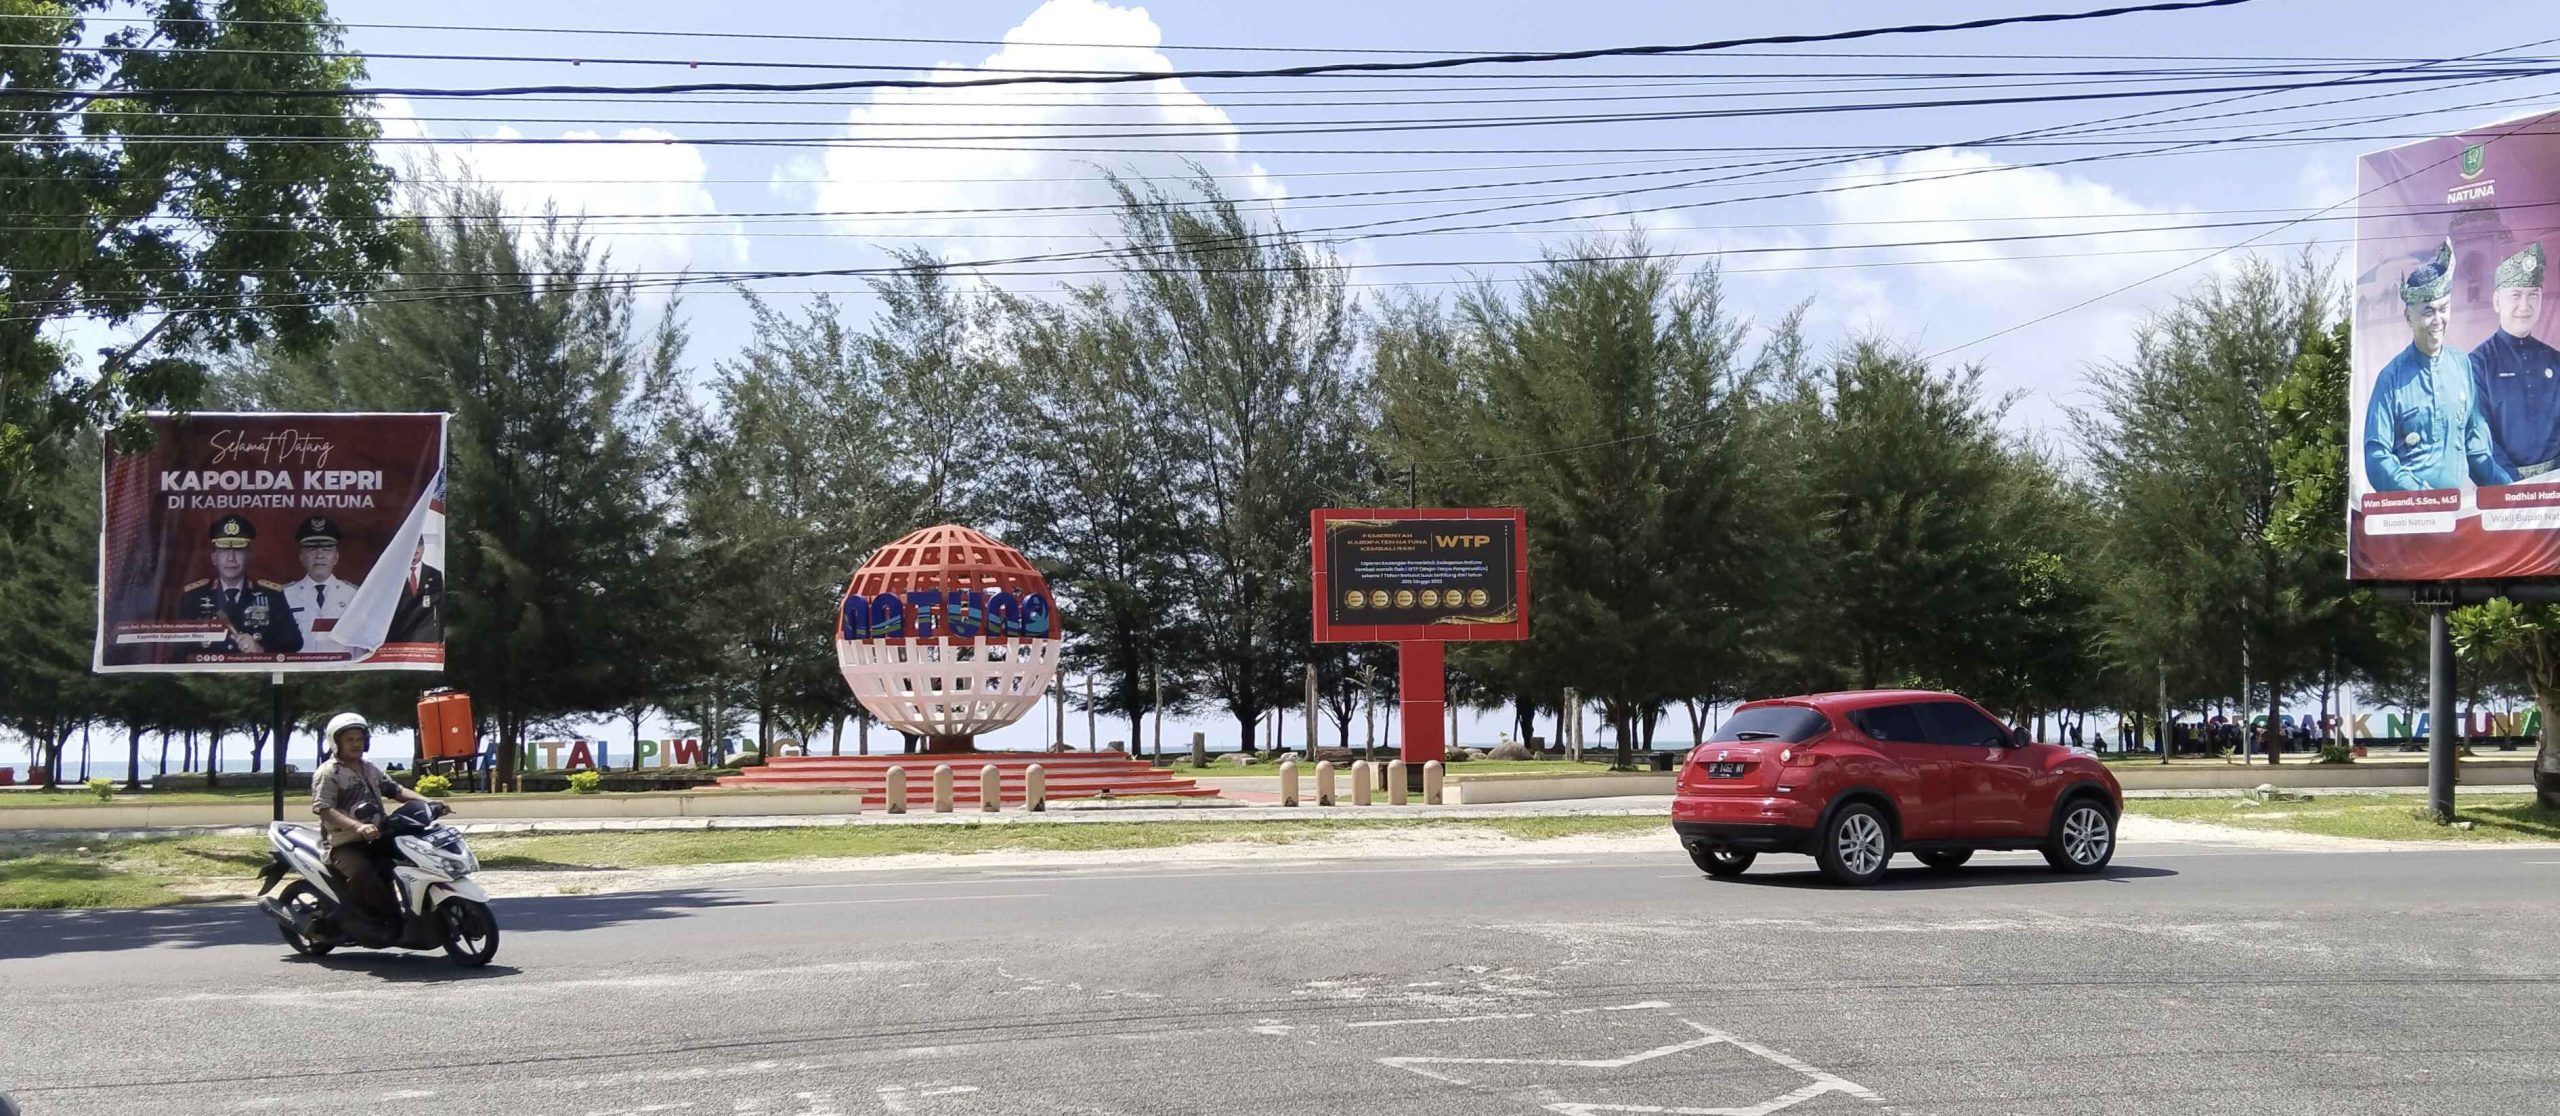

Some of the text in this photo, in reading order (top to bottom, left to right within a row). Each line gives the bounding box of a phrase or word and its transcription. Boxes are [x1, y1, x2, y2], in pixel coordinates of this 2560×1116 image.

[2447, 185, 2496, 204] NATUNA
[210, 429, 334, 468] Selamat Datang
[161, 470, 383, 491] KAPOLDA KEPRI
[168, 494, 375, 509] DI KABUPATEN NATUNA
[2363, 500, 2380, 508] Wan
[2381, 497, 2415, 507] Siswandi,
[2383, 518, 2407, 528] Bupati
[1435, 535, 1491, 548] WTP
[457, 740, 608, 771] ANTAI
